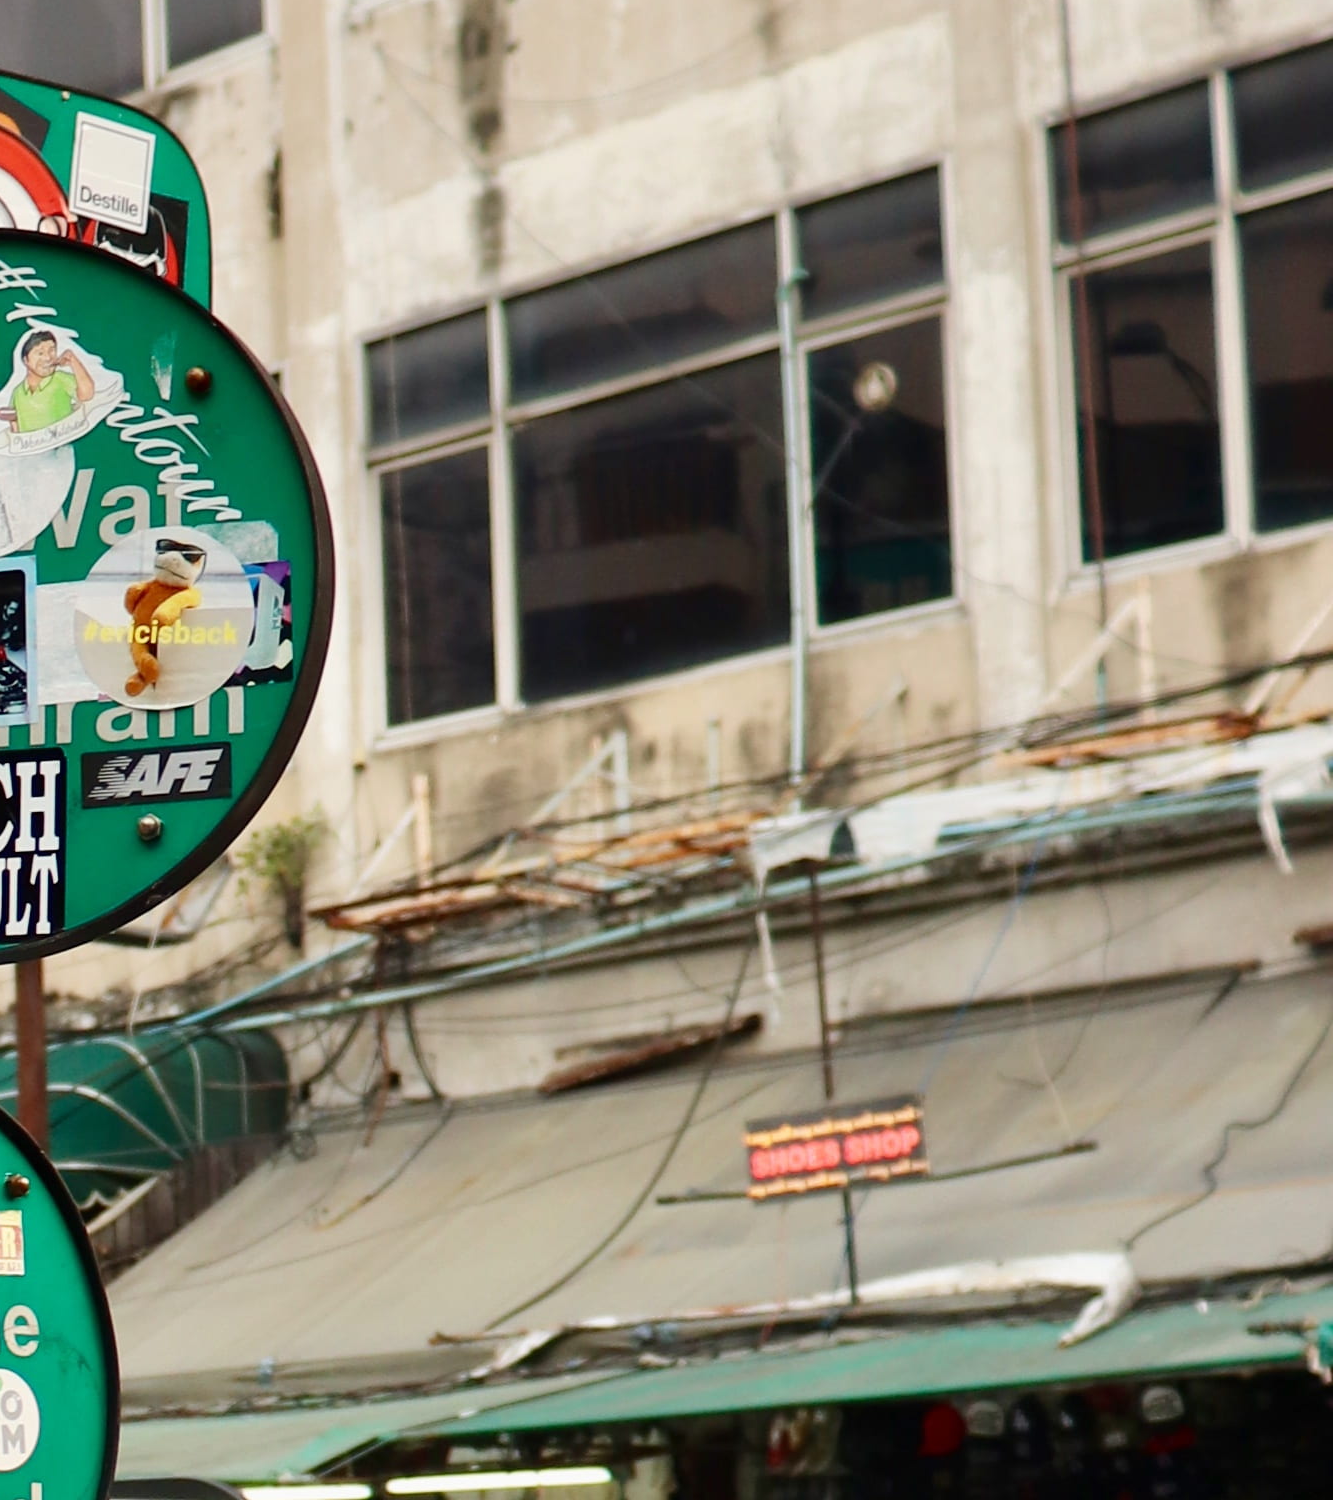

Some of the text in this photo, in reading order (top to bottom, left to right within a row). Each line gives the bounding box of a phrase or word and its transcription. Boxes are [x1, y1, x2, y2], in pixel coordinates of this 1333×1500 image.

[80, 184, 139, 217] Destille
[82, 619, 238, 647] #ericisback
[86, 747, 224, 801] SAFE
[749, 1124, 920, 1182] SHOES SHOP
